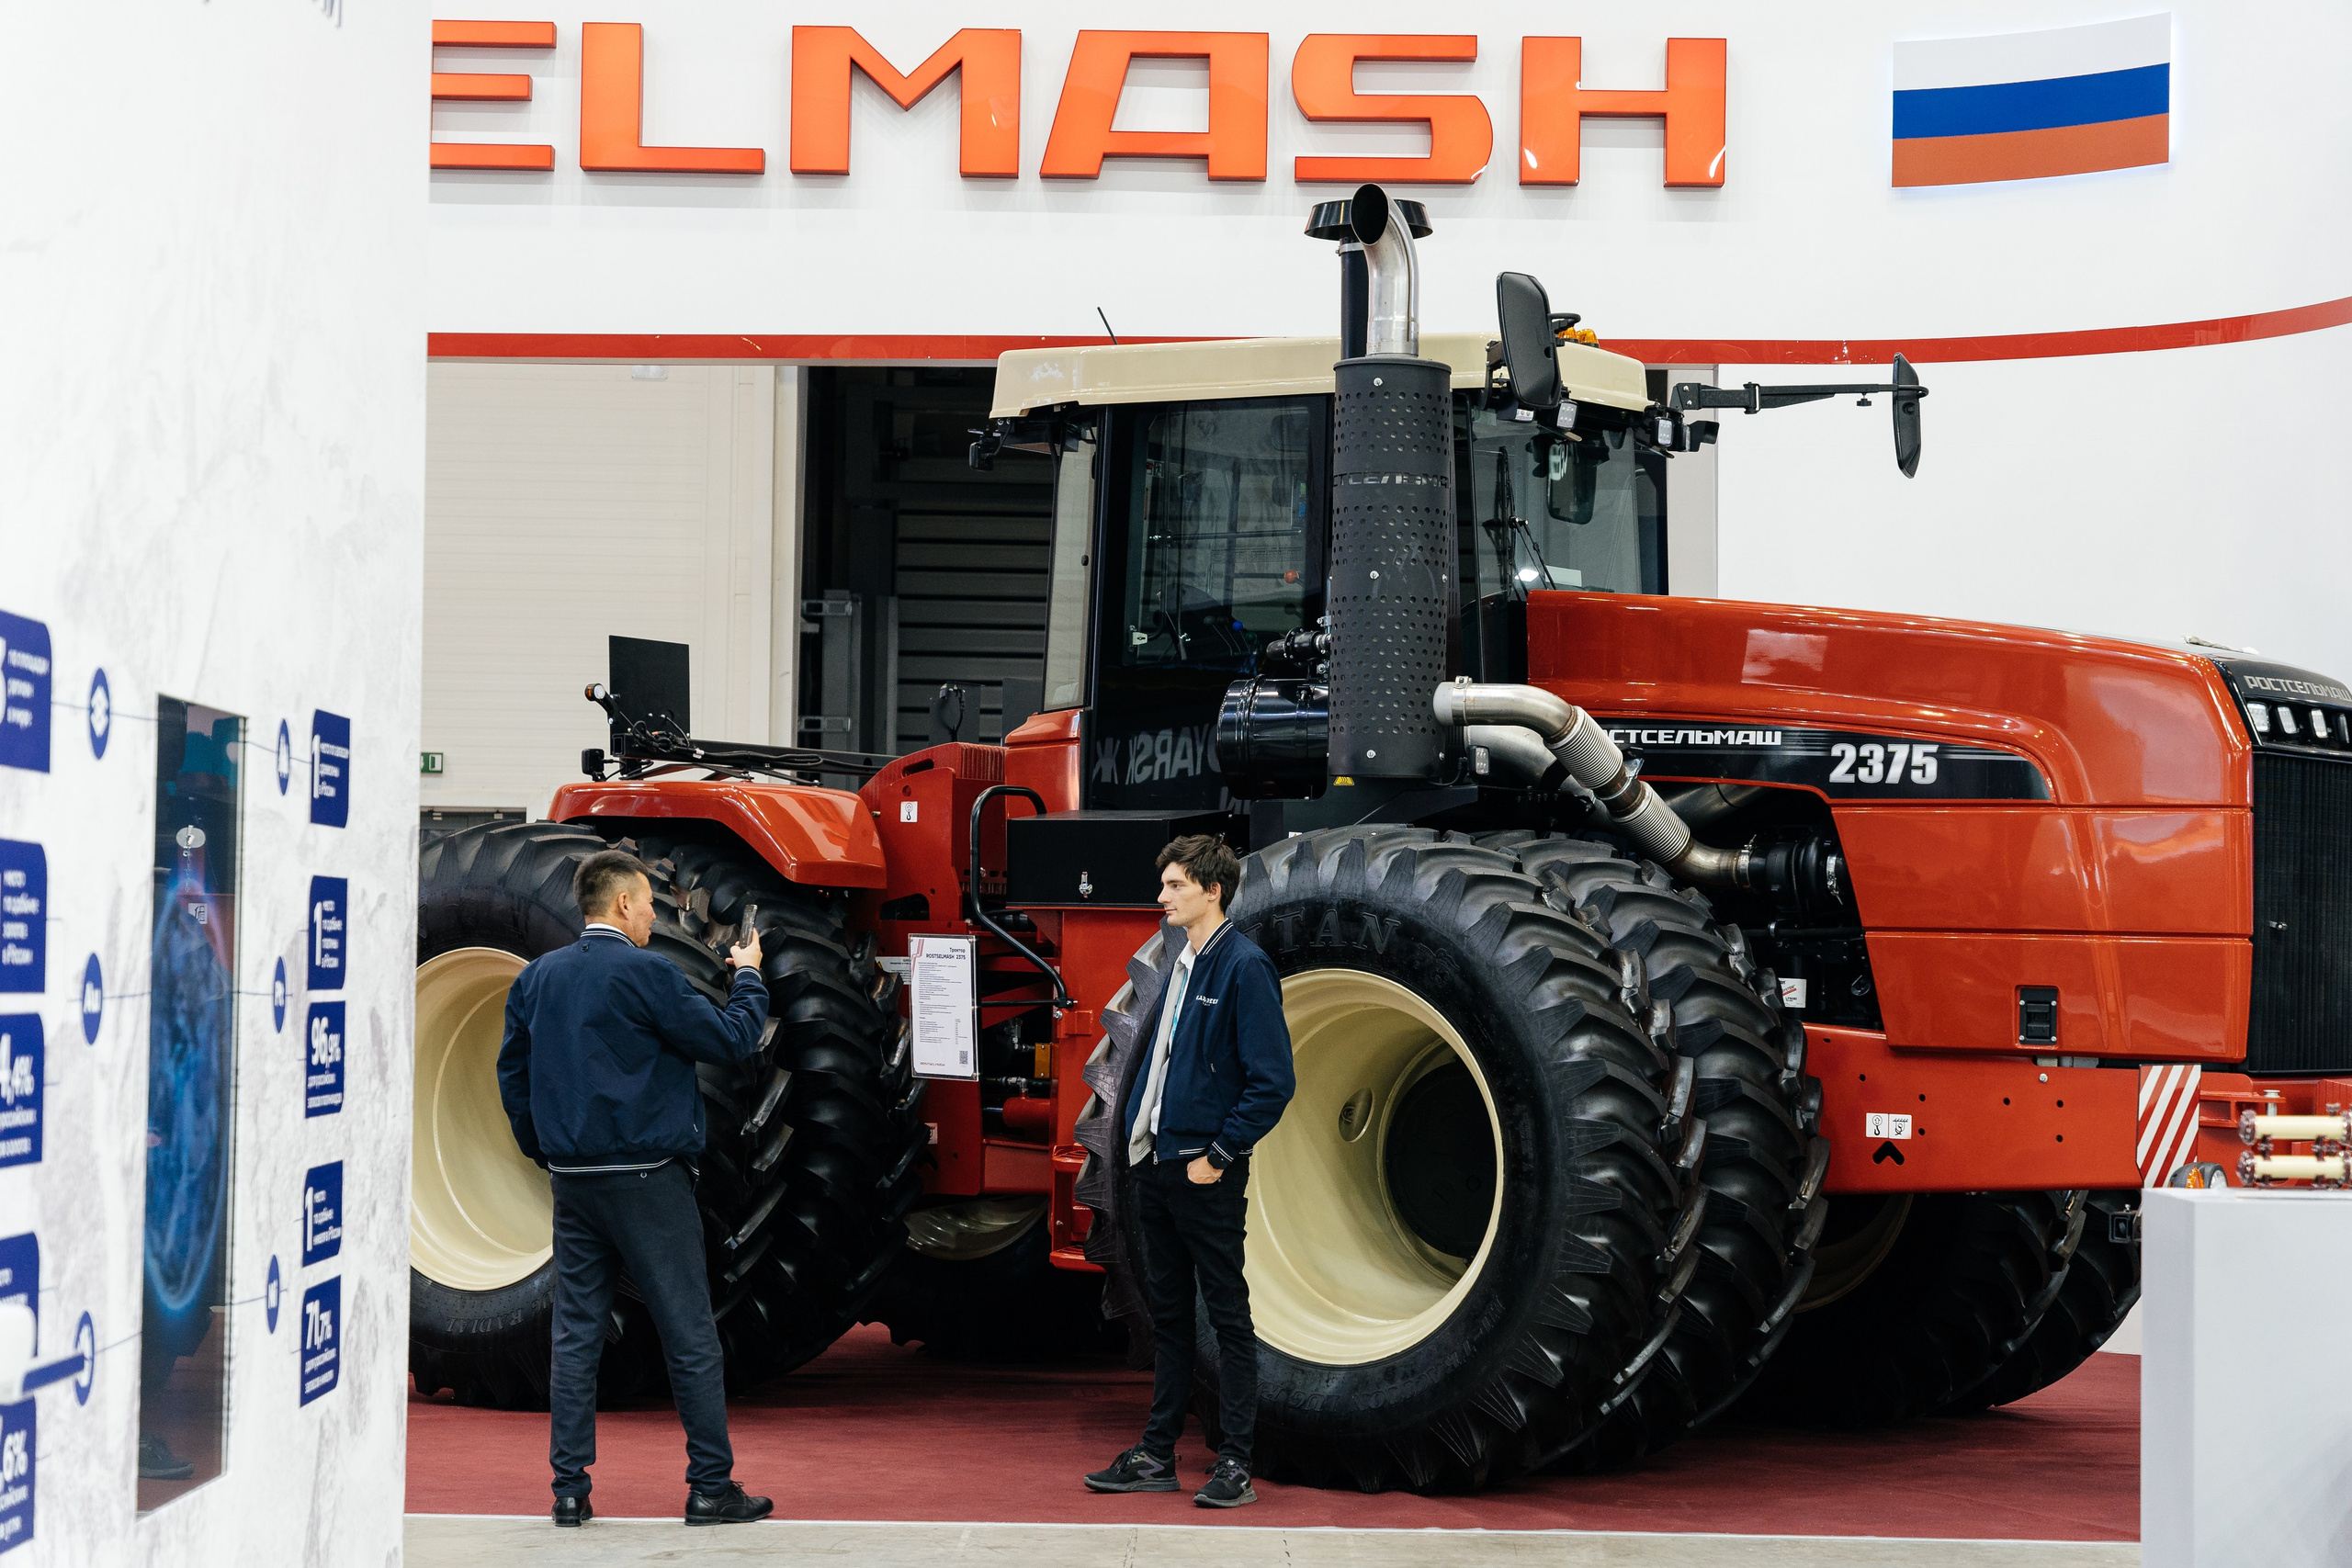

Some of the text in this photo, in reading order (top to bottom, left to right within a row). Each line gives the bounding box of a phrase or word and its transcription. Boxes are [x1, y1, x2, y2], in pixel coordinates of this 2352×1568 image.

[431, 20, 1727, 187] ELMASH
[2244, 675, 2352, 702] РОСТСЕЛЬМАШ
[312, 734, 321, 798] 1
[1604, 729, 1781, 746] СТСЕЛЬМАШ
[1828, 743, 1939, 784] 2375
[313, 901, 322, 966] 1
[311, 1016, 342, 1068] 96,9%
[305, 1186, 313, 1252] 1
